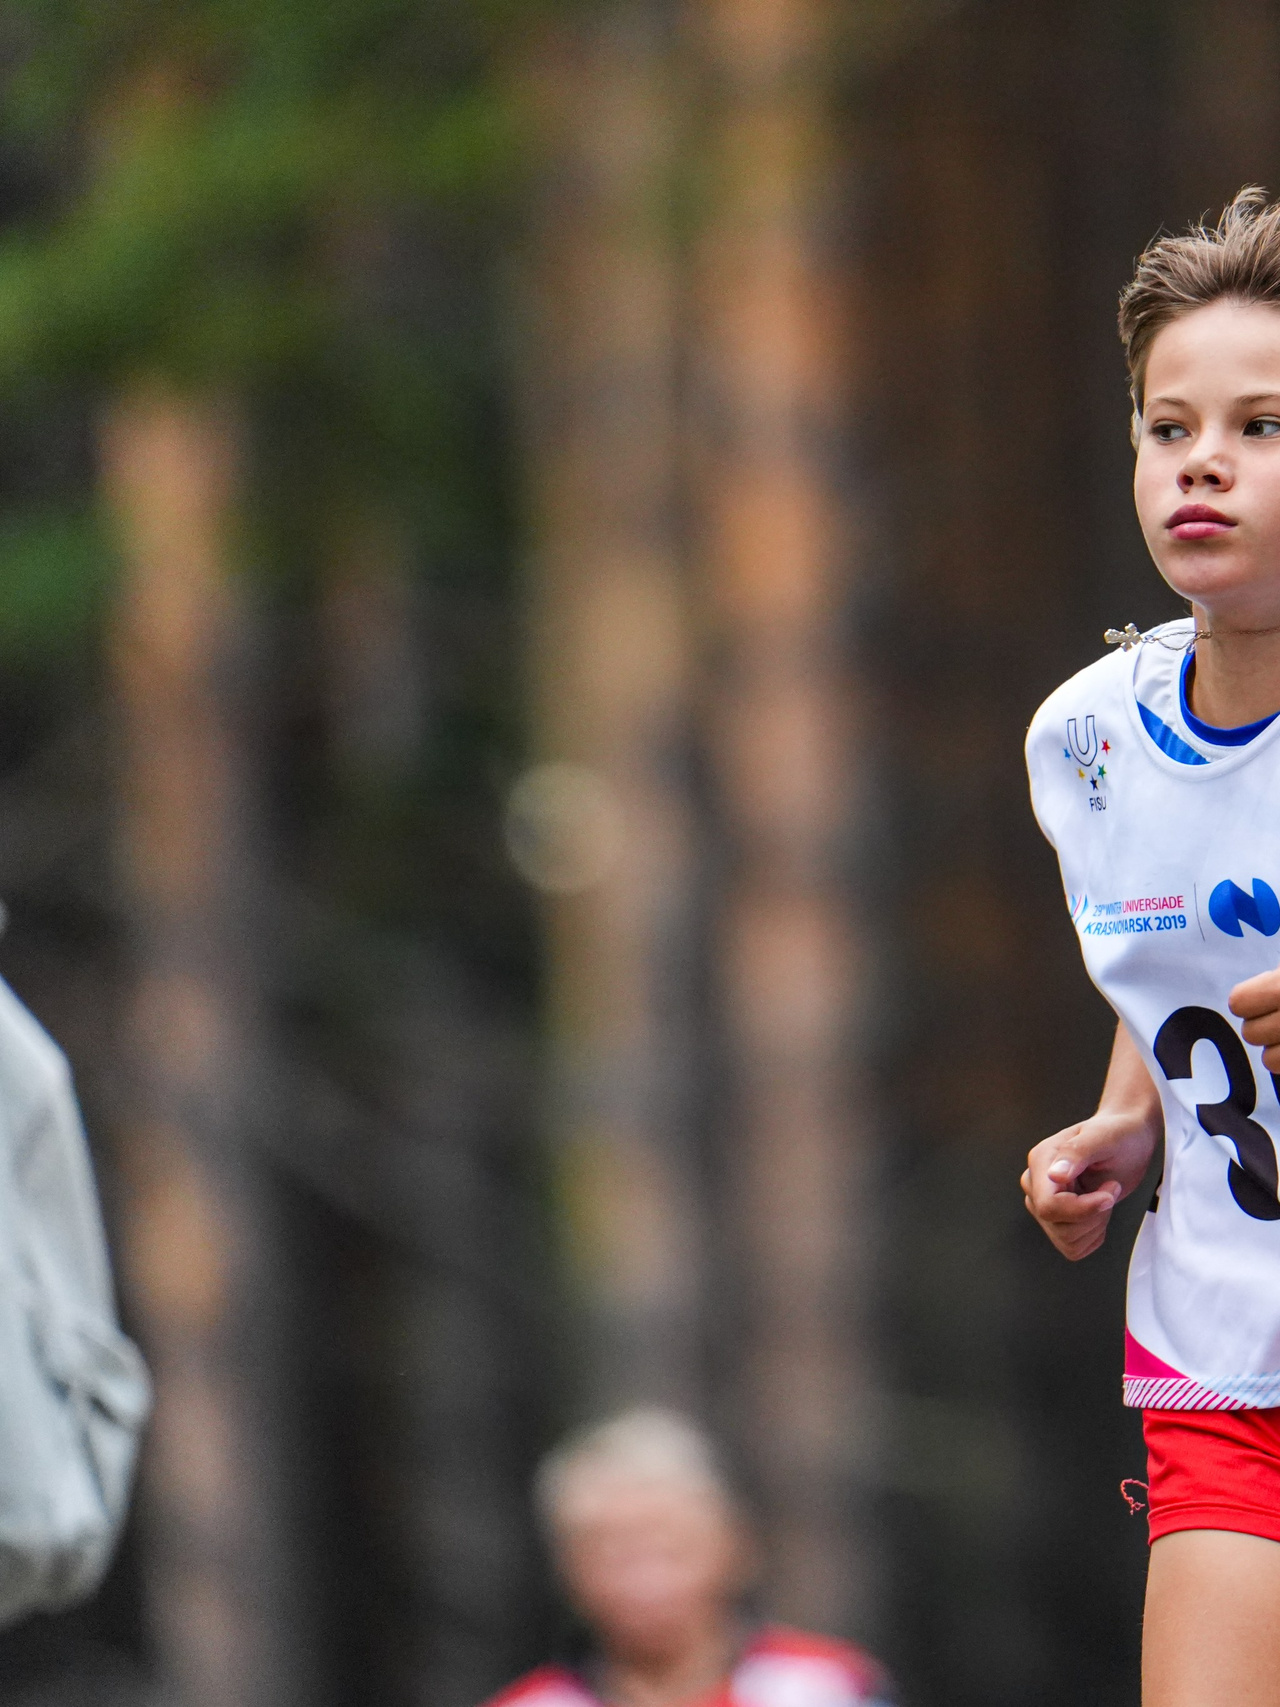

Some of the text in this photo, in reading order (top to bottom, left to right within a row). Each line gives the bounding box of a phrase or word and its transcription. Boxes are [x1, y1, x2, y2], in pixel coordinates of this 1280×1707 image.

[1089, 796, 1106, 811] FISU
[1122, 896, 1184, 913] UNIVERSIADE
[1154, 914, 1187, 930] 2019
